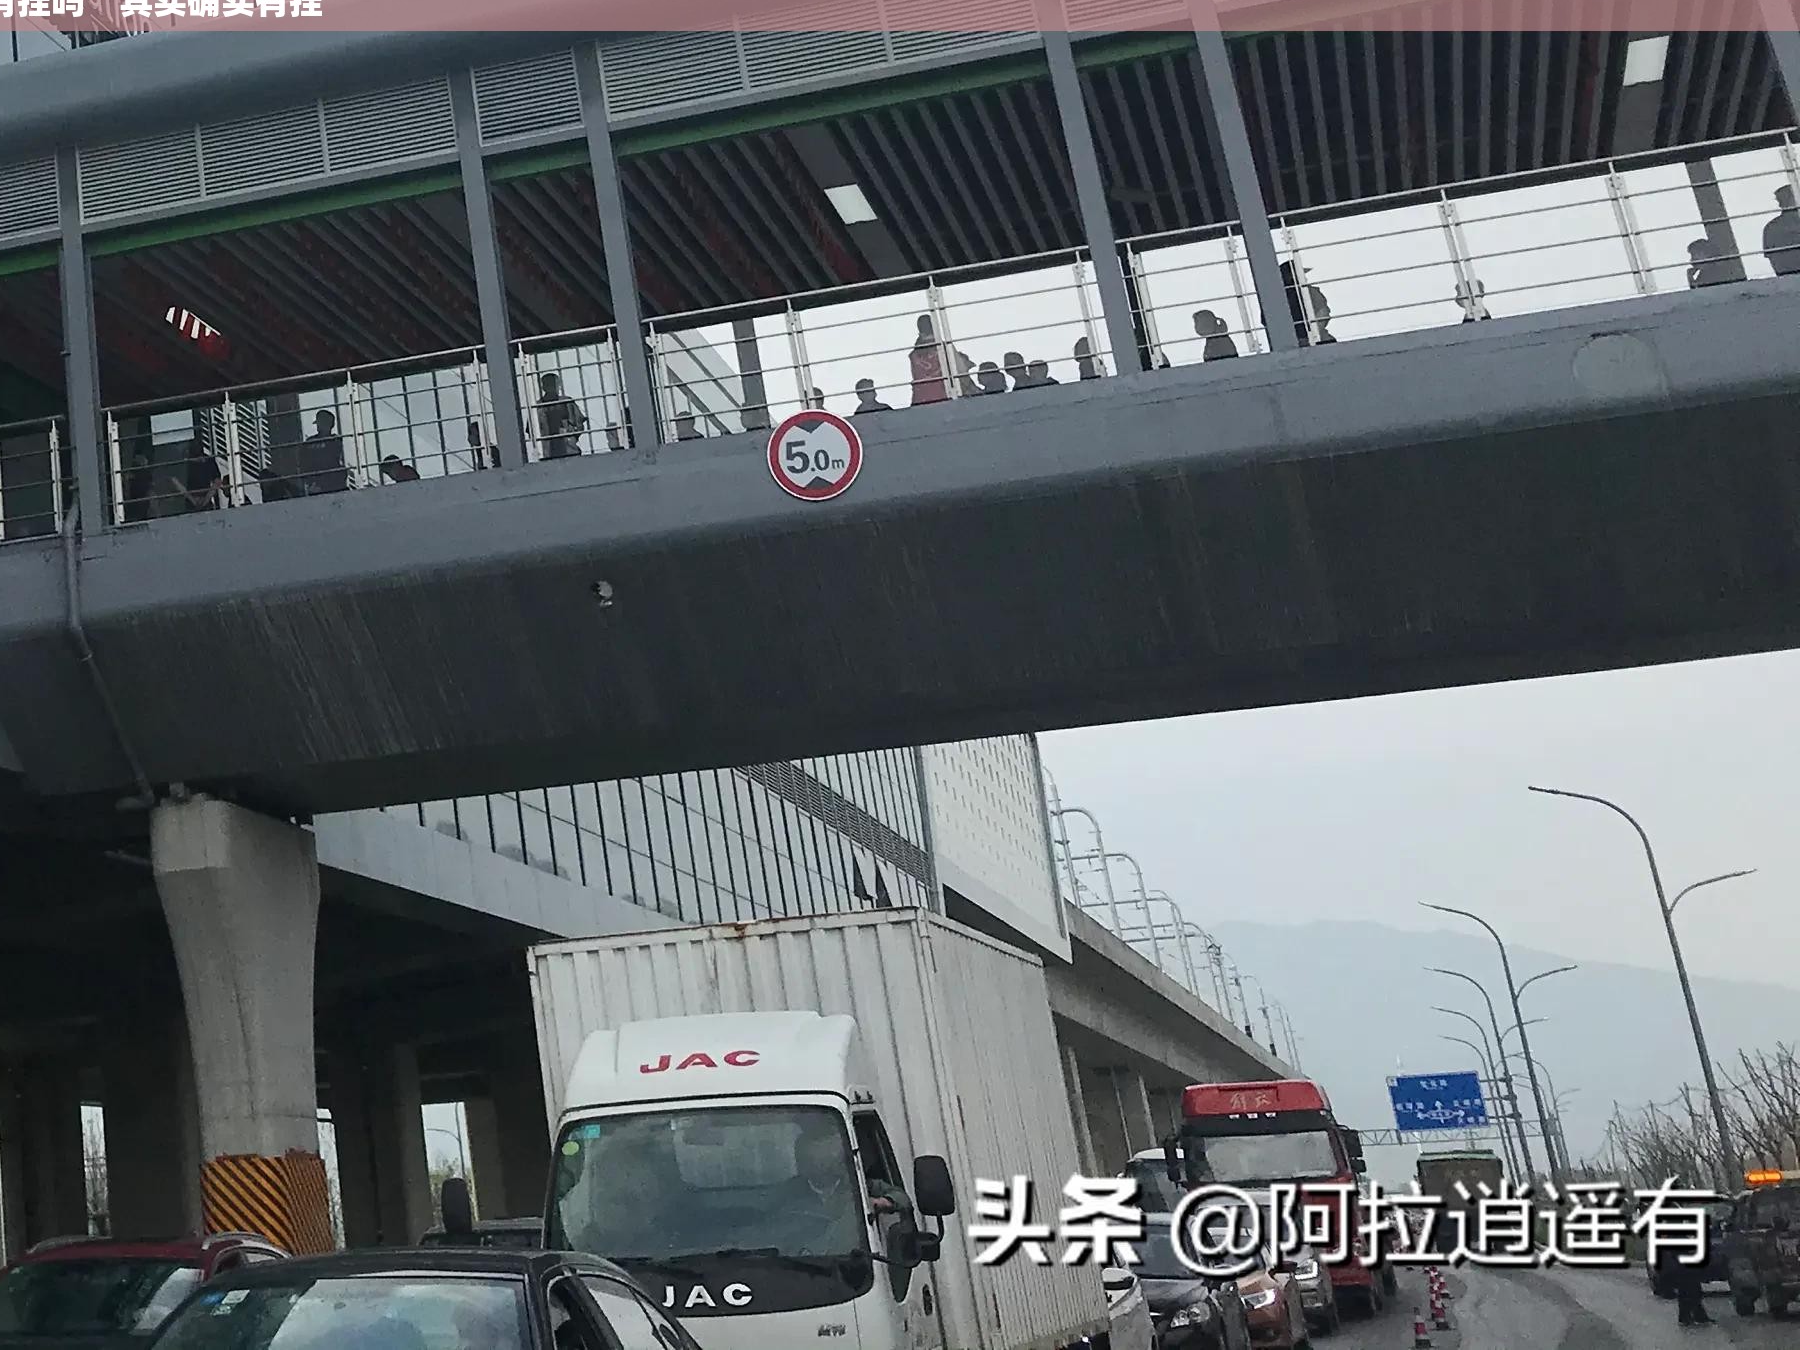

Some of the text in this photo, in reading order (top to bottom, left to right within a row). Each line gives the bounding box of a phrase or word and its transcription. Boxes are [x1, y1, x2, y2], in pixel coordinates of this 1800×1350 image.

[785, 440, 845, 474] 5.0m
[639, 1049, 761, 1074] JAC
[661, 1282, 753, 1308] JAC
